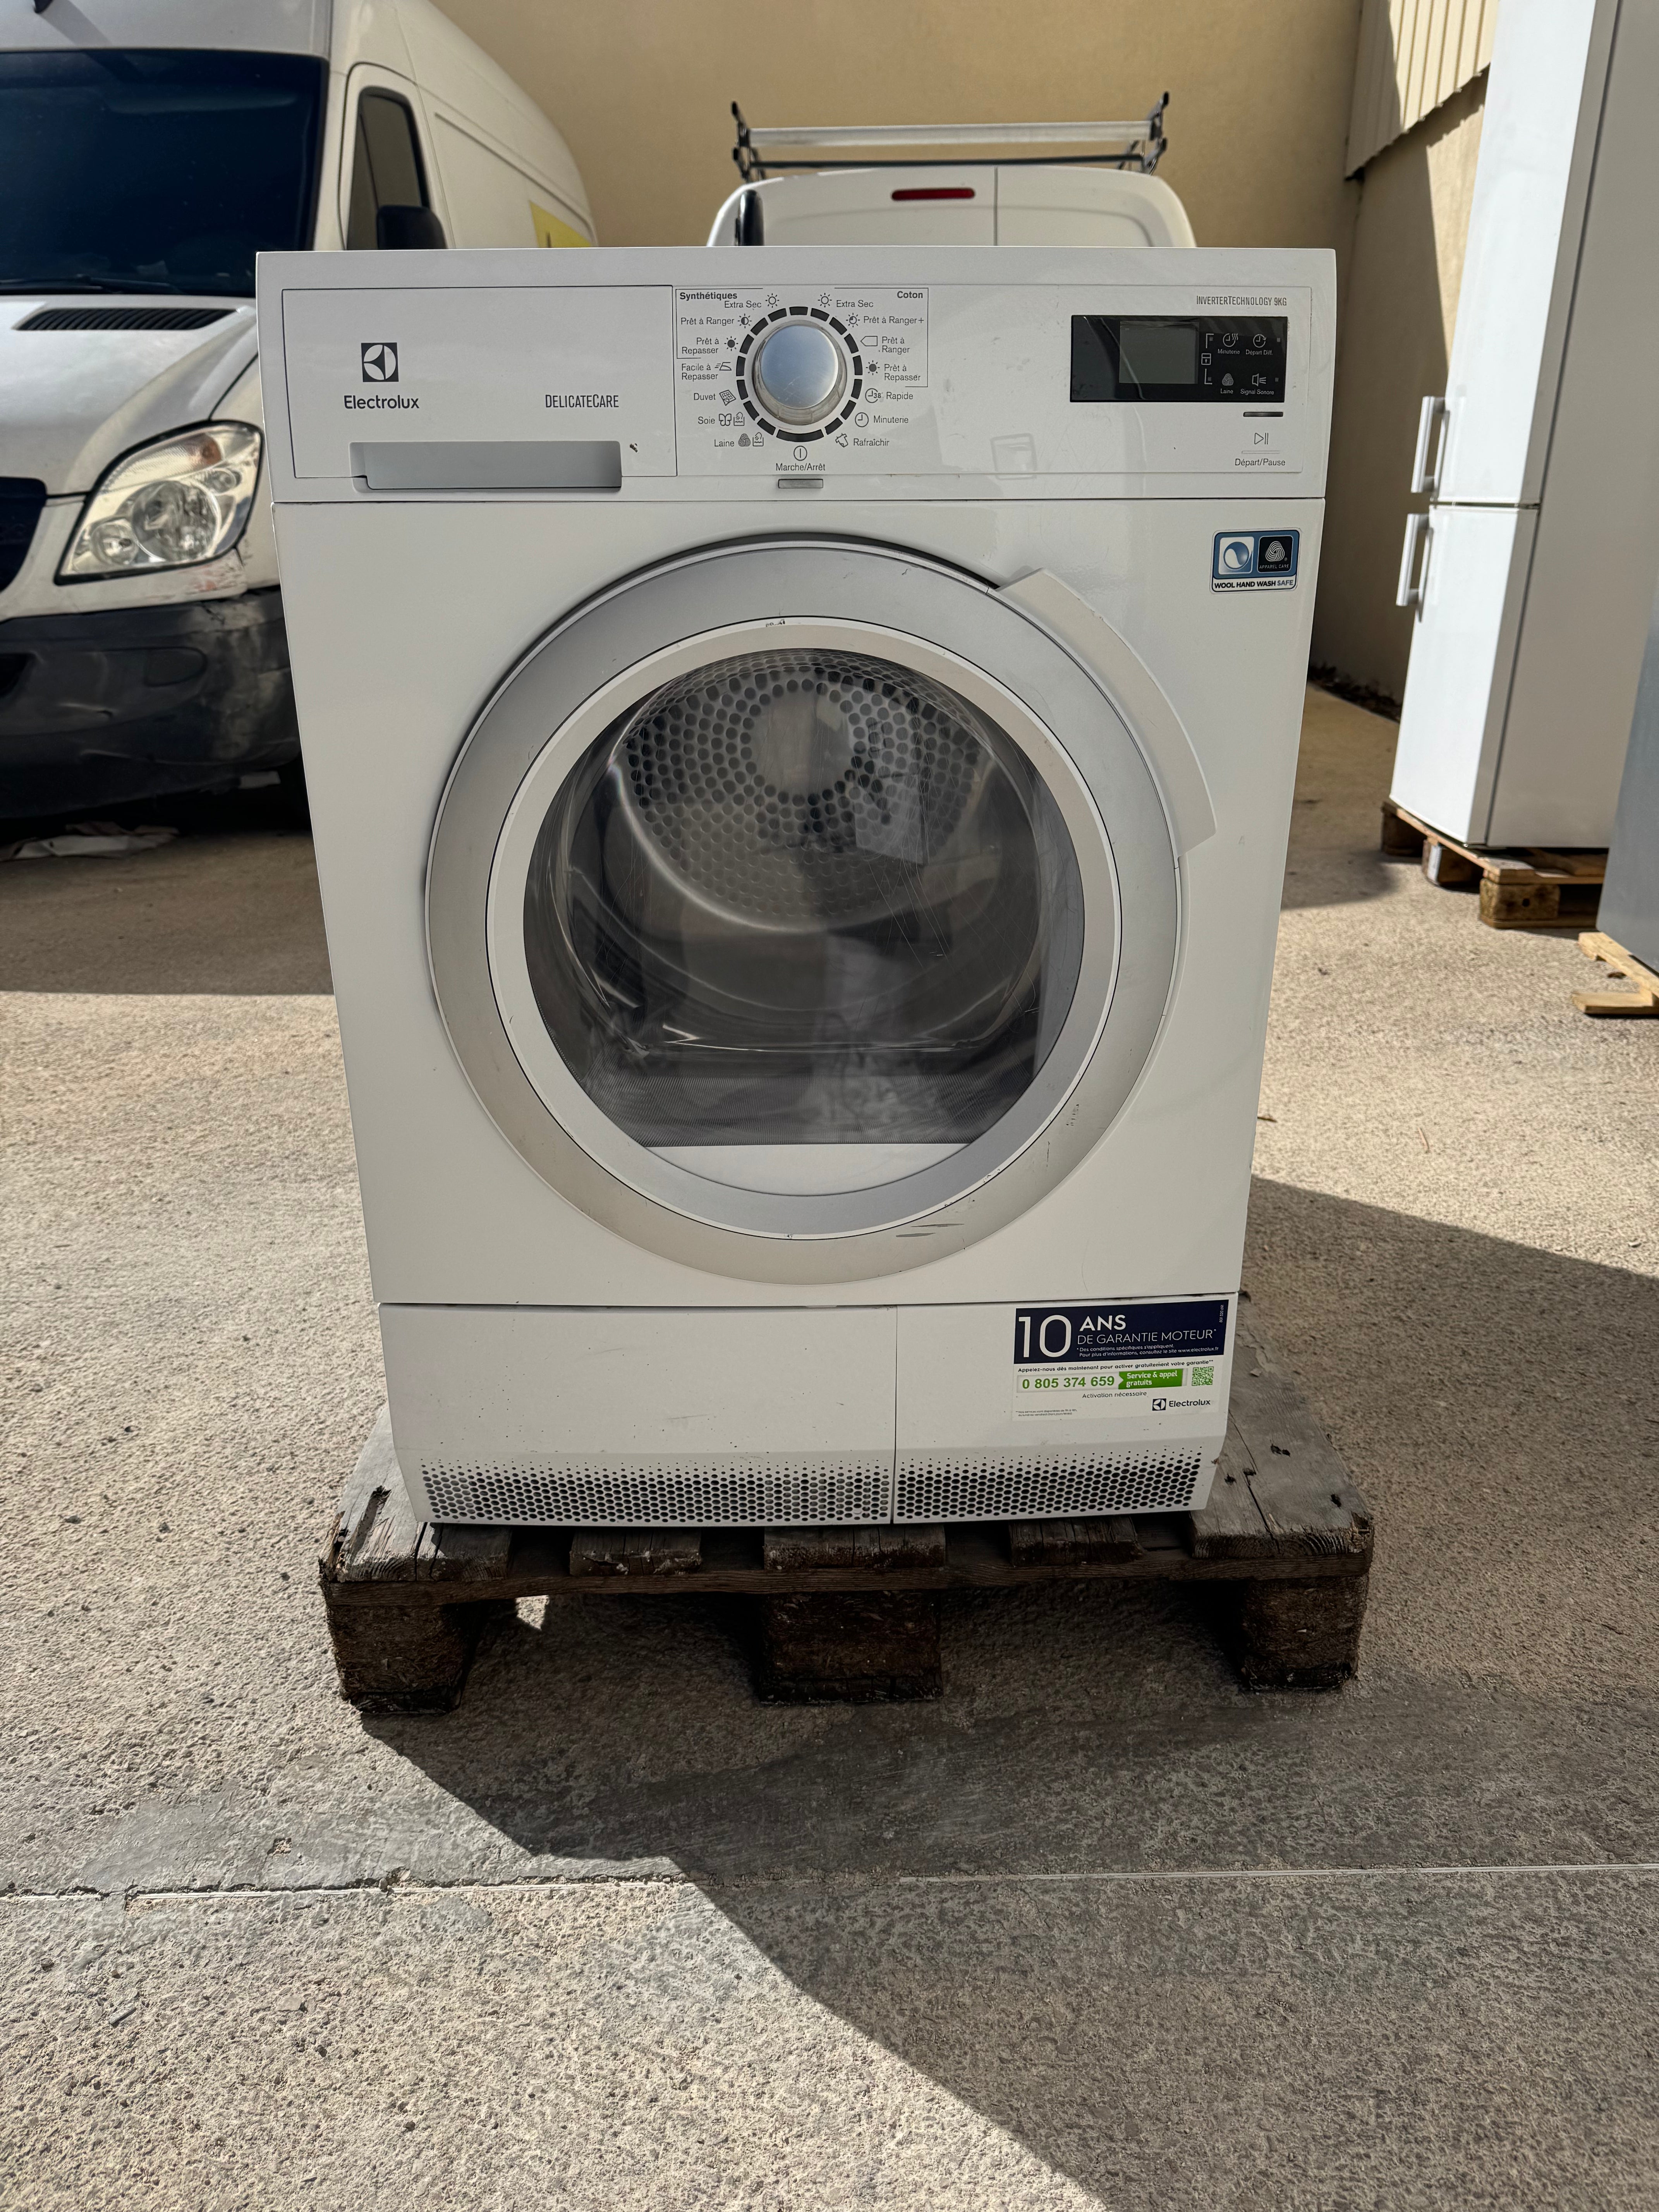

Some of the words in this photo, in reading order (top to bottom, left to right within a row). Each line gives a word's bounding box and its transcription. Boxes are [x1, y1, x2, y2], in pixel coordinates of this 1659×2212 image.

[679, 292, 737, 301] Synthétiques
[1274, 297, 1287, 306] 9KG
[681, 317, 697, 325] Prêt
[706, 317, 735, 326] Ranger
[889, 316, 924, 325] Ranger+
[682, 347, 718, 355] Repasser
[882, 346, 910, 355] Ranger
[884, 364, 900, 372] Prêt
[682, 373, 718, 381] Repasser
[884, 373, 921, 382] Repasser
[886, 392, 913, 401] Rapide
[344, 394, 420, 410] Electrolux
[698, 416, 715, 424] Soie
[714, 439, 735, 447] Laine
[853, 438, 890, 447] Rafraîchir
[776, 463, 825, 471] Marche/Arrêt
[1235, 458, 1286, 467] Départ/Pause
[1079, 1315, 1126, 1331] ANS
[1018, 1315, 1072, 1358] 10
[1078, 1335, 1093, 1344] DE
[1097, 1333, 1158, 1343] GARANTIE
[1159, 1370, 1178, 1379] appel
[1022, 1379, 1030, 1389] 0
[1035, 1378, 1058, 1388] 805
[1063, 1377, 1086, 1388] 374
[1091, 1376, 1115, 1386] 659
[1127, 1379, 1152, 1388] gratuits
